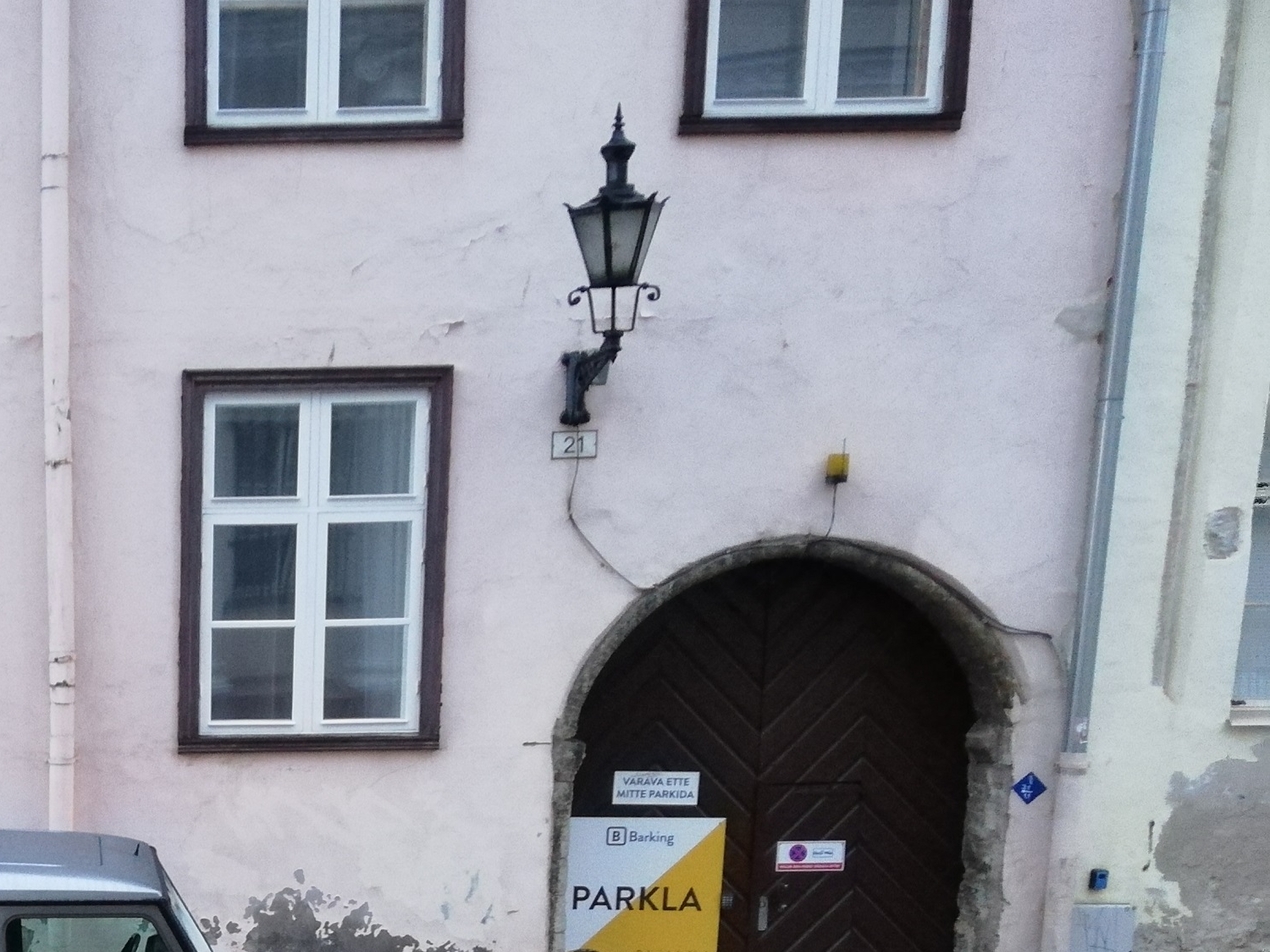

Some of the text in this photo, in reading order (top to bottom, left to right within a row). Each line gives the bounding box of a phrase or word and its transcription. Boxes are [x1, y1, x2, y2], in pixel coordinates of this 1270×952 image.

[564, 436, 584, 454] 21
[623, 777, 691, 786] VARAVA ETTE
[616, 790, 694, 799] MITTE PARKIDA
[629, 830, 675, 846] Barking
[572, 885, 702, 912] PARKLA
